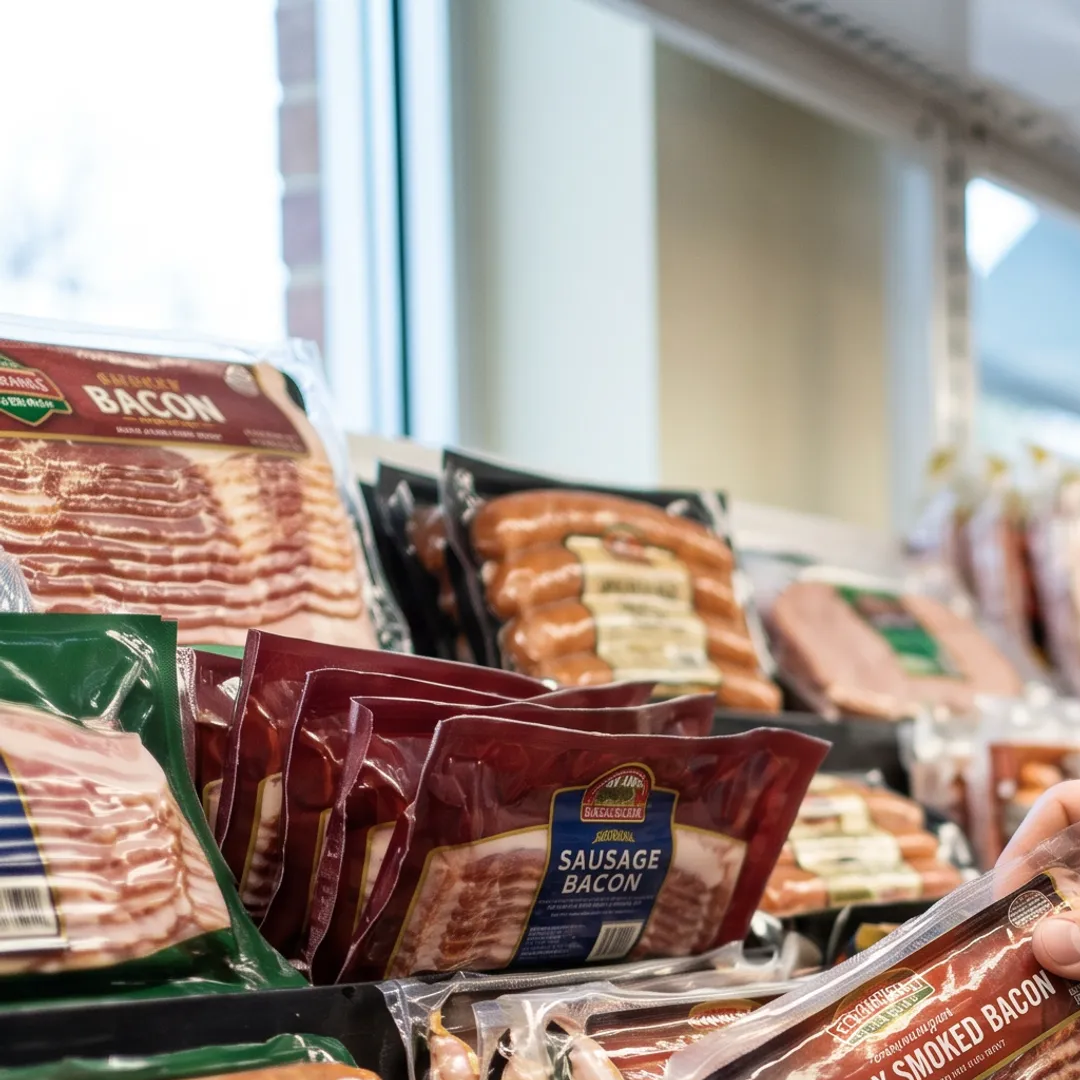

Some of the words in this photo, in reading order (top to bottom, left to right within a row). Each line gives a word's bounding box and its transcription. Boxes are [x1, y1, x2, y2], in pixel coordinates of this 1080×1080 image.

[82, 385, 226, 423] BACON
[558, 850, 661, 870] SAUSAGE
[561, 874, 642, 894] BACON
[981, 970, 1056, 1032] BACON
